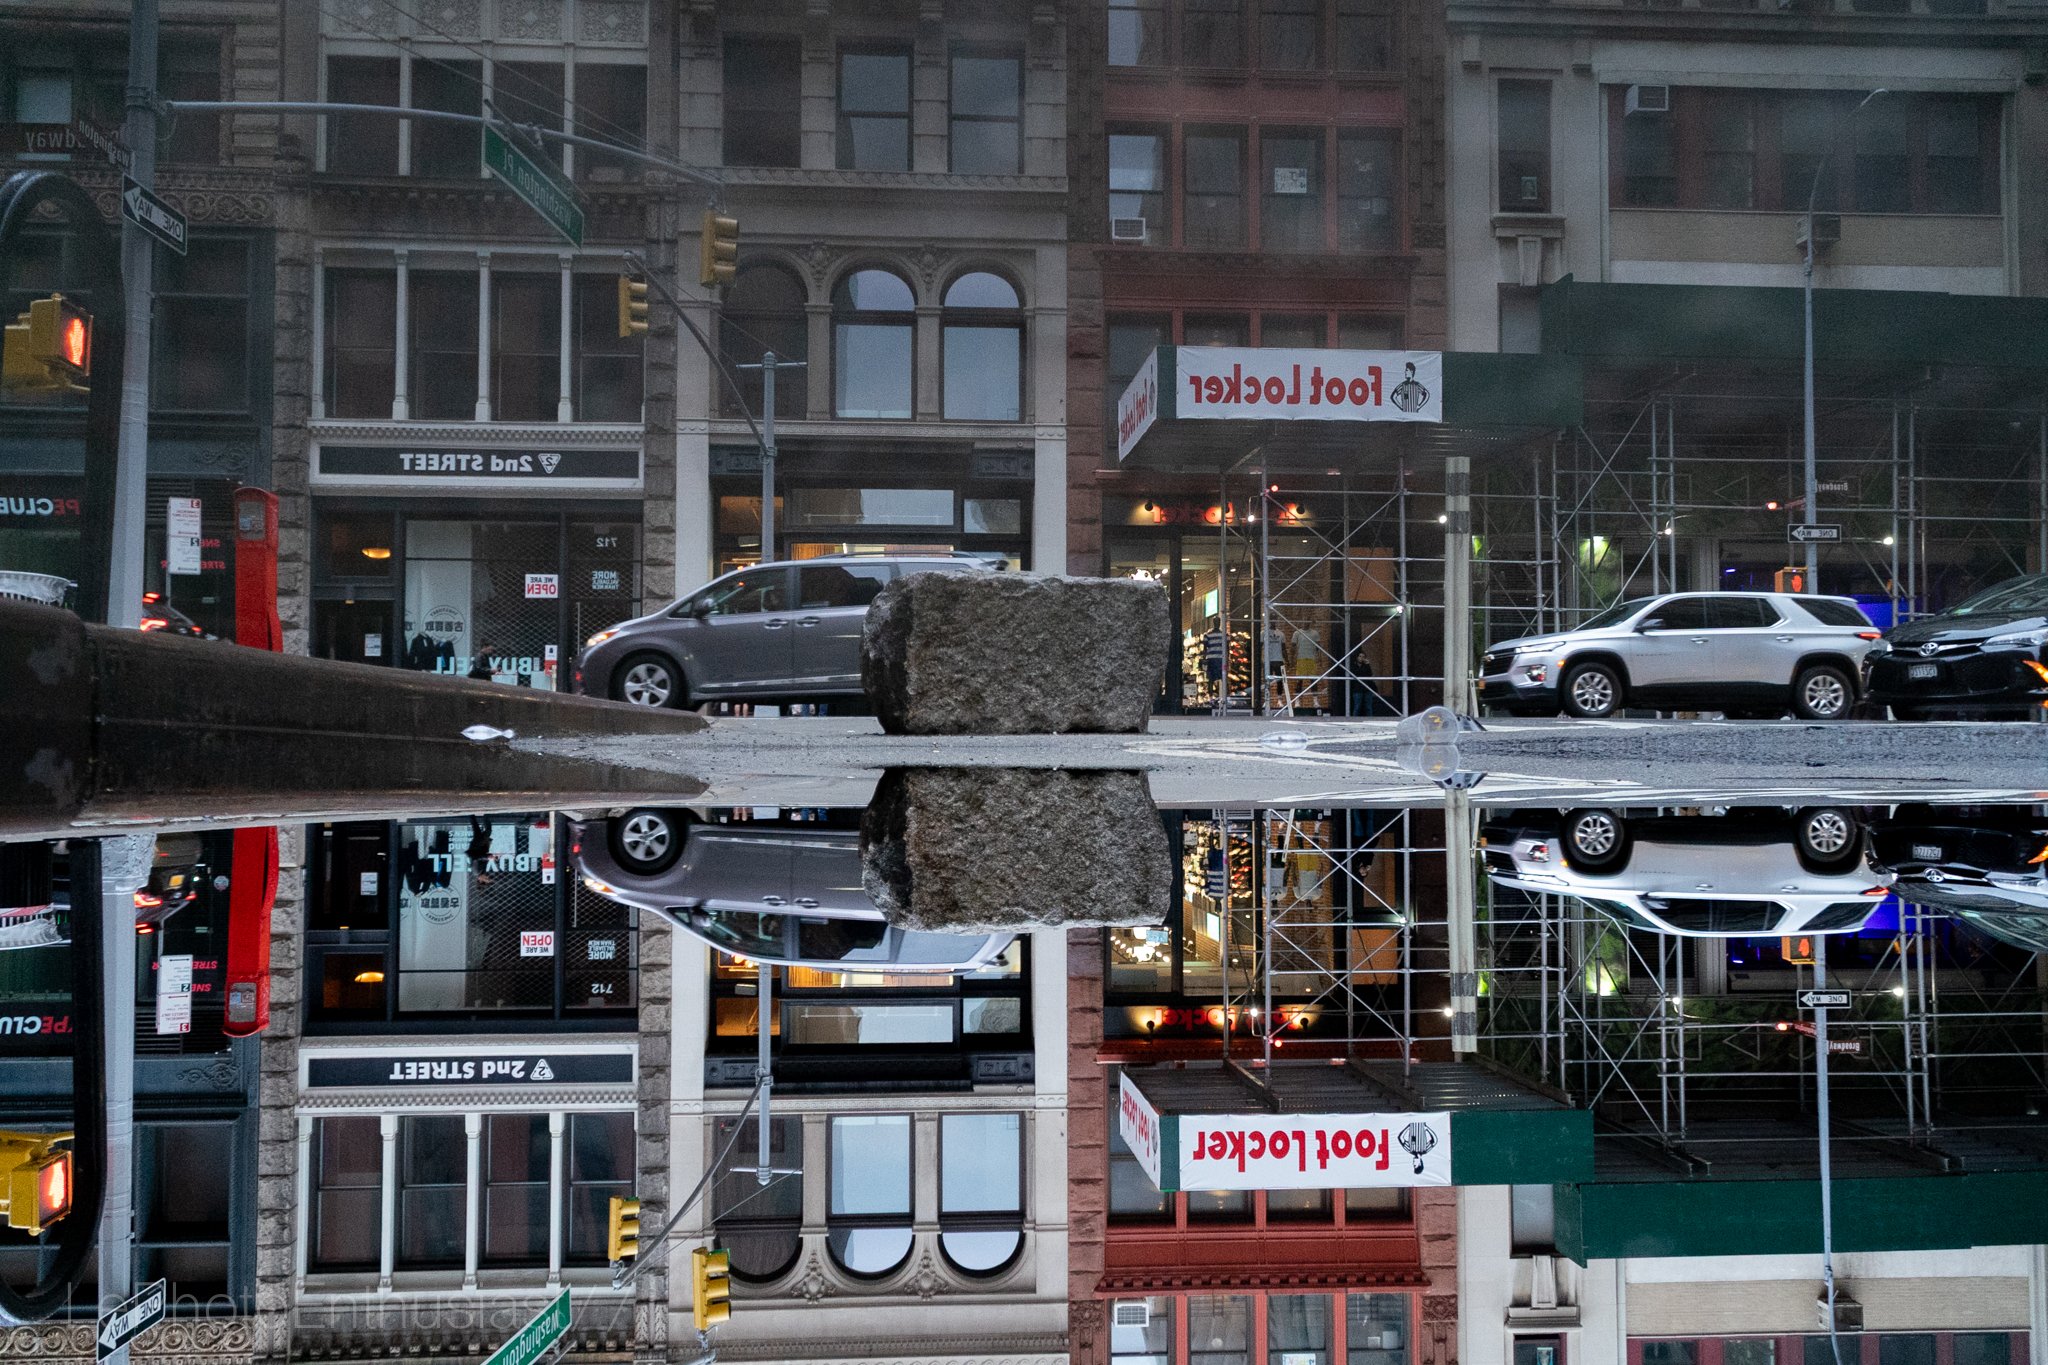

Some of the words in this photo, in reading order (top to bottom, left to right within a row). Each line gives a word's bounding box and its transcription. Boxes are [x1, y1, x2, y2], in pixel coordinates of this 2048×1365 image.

[522, 934, 552, 945] OPEN
[588, 951, 613, 960] MORE
[591, 983, 613, 993] 712
[0, 1016, 73, 1034] PECLU
[1830, 1041, 1860, 1051] Broadway
[389, 1059, 475, 1079] STREET
[473, 1058, 526, 1079] 2nd
[1122, 1088, 1137, 1141] Locker
[1137, 1107, 1150, 1158] Foot
[1193, 1128, 1306, 1173] Locker
[1315, 1128, 1389, 1172] Foot
[139, 1295, 160, 1321] ONE
[106, 1316, 129, 1343] WAY
[502, 1309, 559, 1365] Washington
